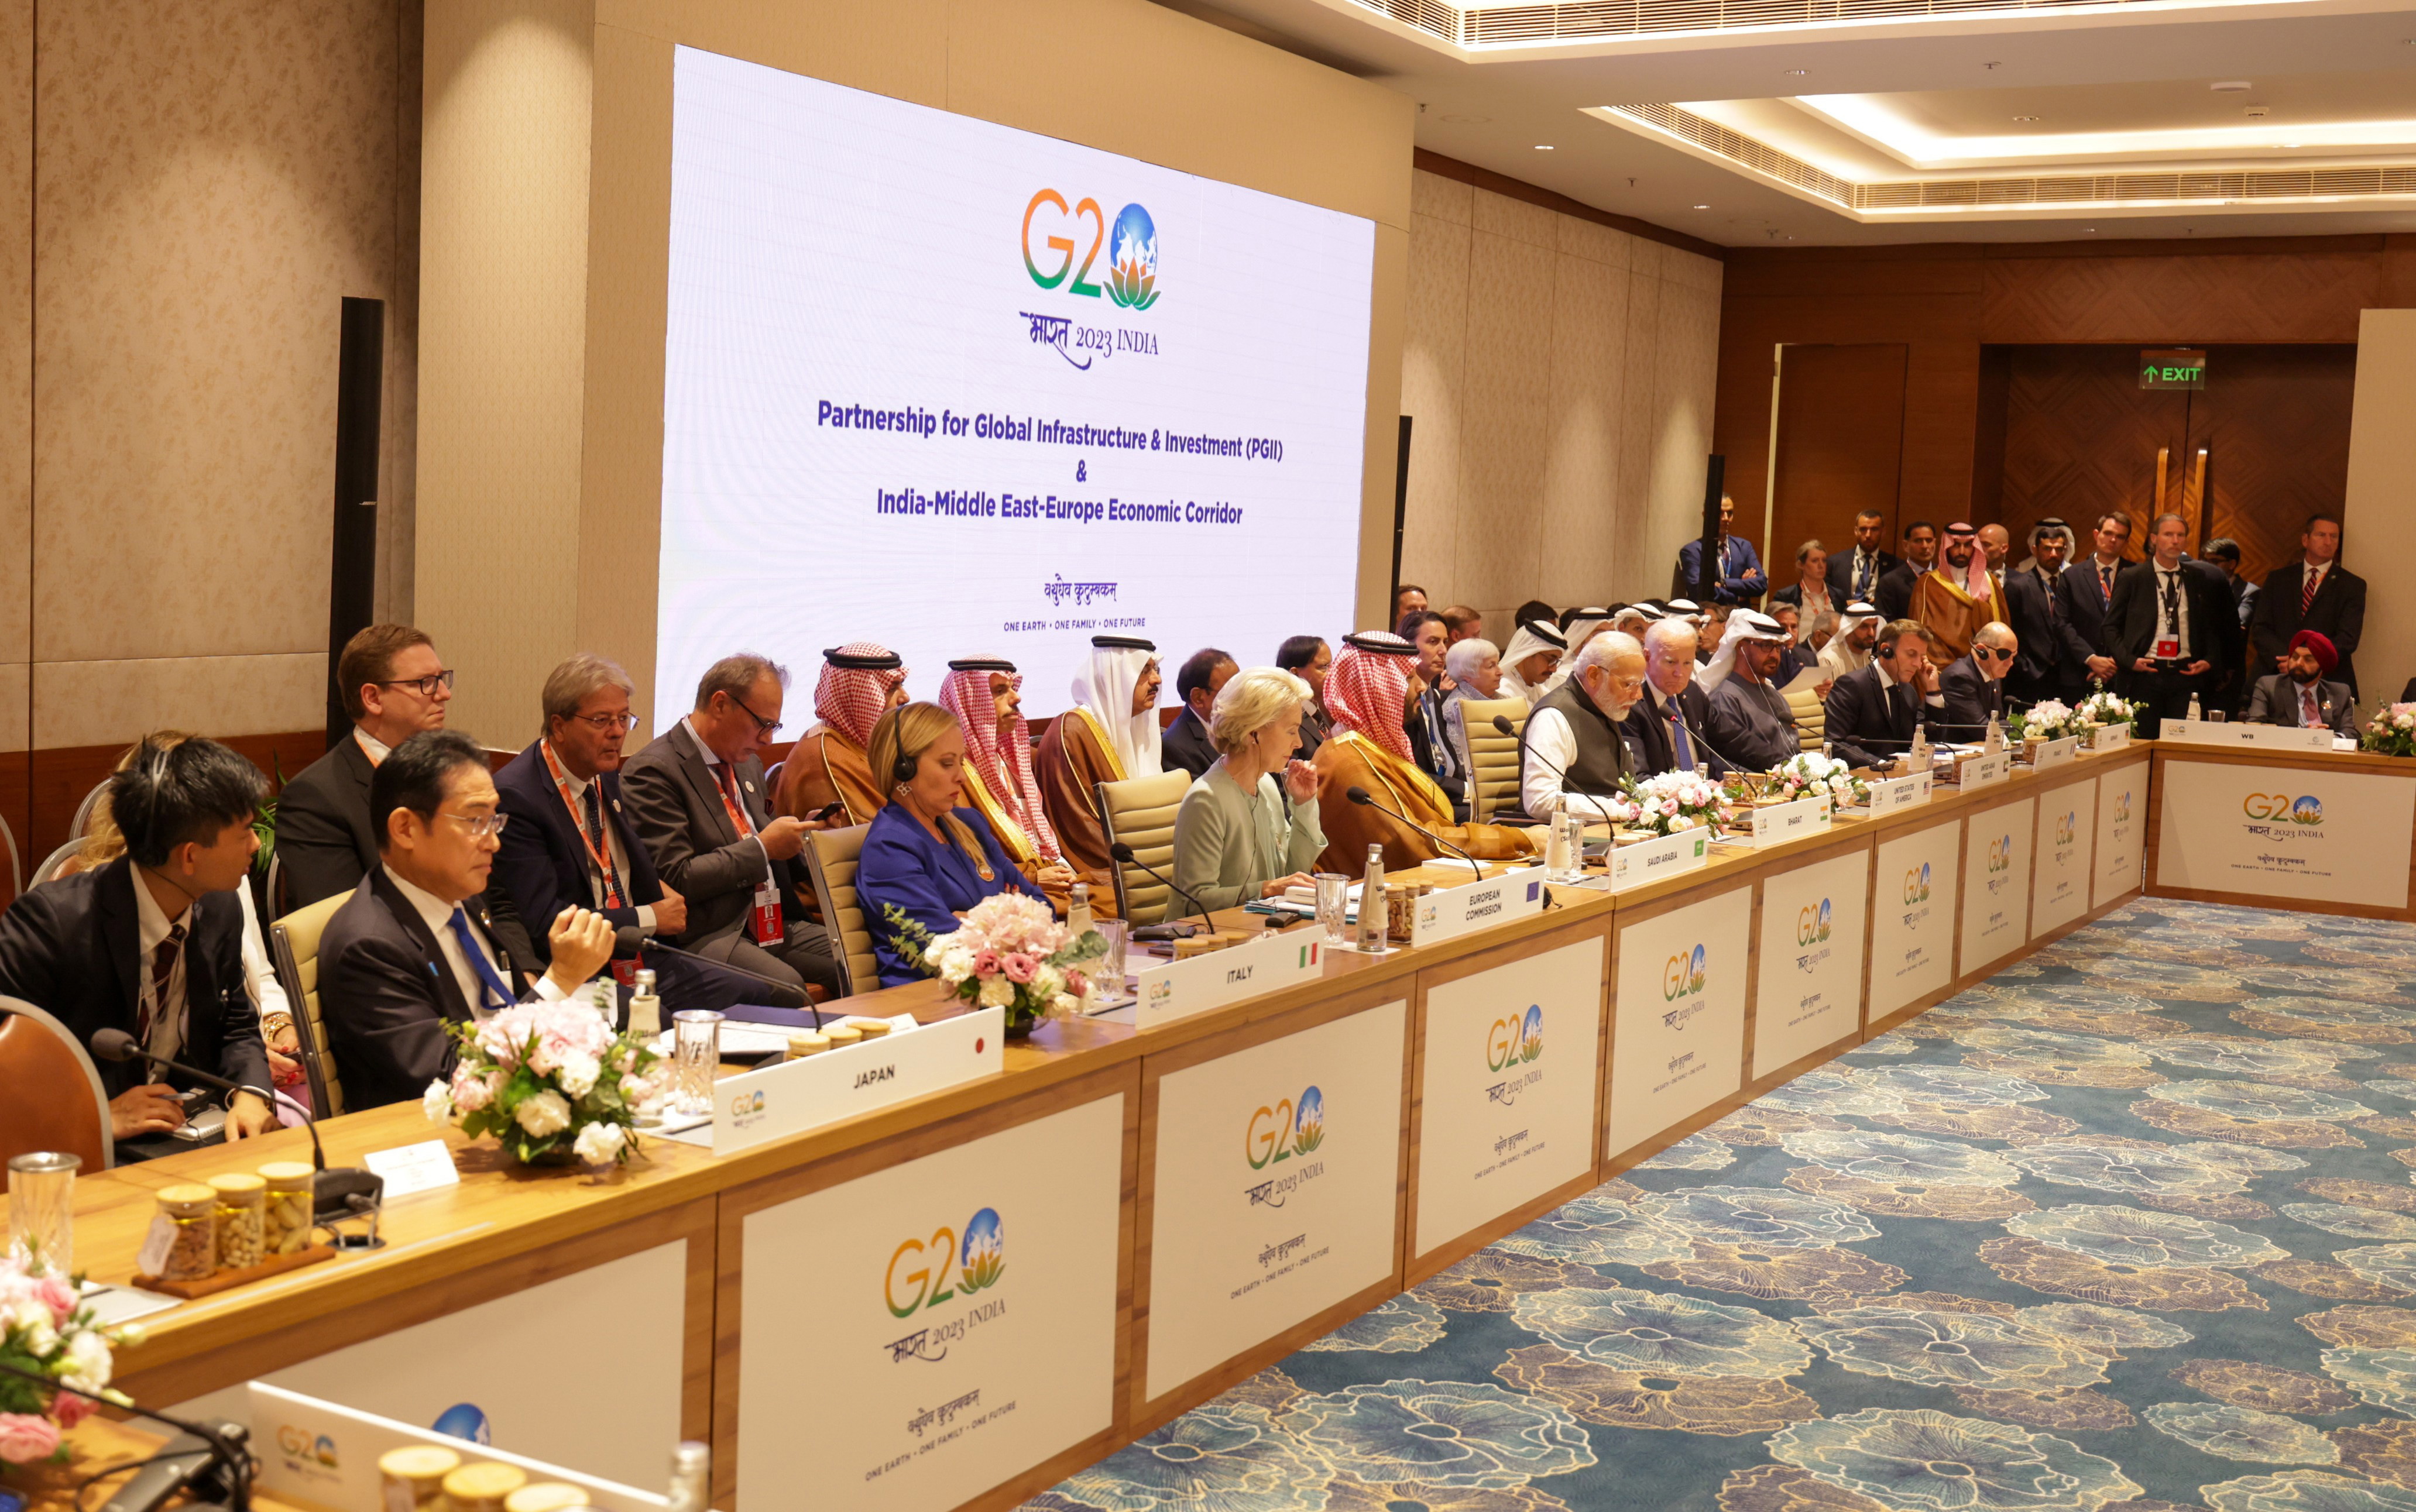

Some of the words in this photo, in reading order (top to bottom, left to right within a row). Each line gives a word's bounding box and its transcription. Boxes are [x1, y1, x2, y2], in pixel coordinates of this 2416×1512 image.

[1021, 188, 1161, 311] G20
[1019, 311, 1092, 370] भारत
[1076, 327, 1112, 358] 2023
[1117, 329, 1159, 355] INDIA
[2162, 367, 2201, 381] EXIT
[818, 400, 936, 438] Partnership
[942, 410, 969, 437] for
[974, 413, 1032, 441] Global
[1037, 419, 1147, 450] Infrastructure
[1151, 428, 1161, 451] &
[1165, 430, 1243, 457] Investment
[1245, 438, 1283, 463] (PGII)
[1076, 459, 1087, 482] &
[877, 487, 996, 517] India-Middle
[1001, 494, 1104, 524] East-Europe
[1109, 498, 1181, 523] Economic
[1185, 500, 1243, 524] Corridor
[1004, 622, 1020, 631] ONE
[1022, 621, 1046, 631] EARTH
[1055, 620, 1069, 630] ONE
[1072, 619, 1096, 629] FAMILY
[1104, 618, 1118, 628] ONE
[1120, 618, 1145, 627] FUTURE
[1788, 816, 1802, 826] BHARAT
[2243, 792, 2324, 826] G20
[2274, 829, 2295, 838] 2023
[2298, 830, 2324, 839] INDIA
[1648, 857, 1661, 867] SAUDI
[1662, 851, 1677, 863] ARABIA
[1470, 889, 1501, 906] EUROPEAN
[1904, 862, 1930, 906] G20
[1466, 902, 1502, 920] COMMISSION
[1797, 898, 1831, 947] G20
[1227, 965, 1253, 984] ITALY
[1664, 943, 1706, 1002] G20
[1679, 1008, 1690, 1020] 2023
[1691, 1000, 1705, 1014] INDIA
[1487, 1004, 1543, 1073] G20
[853, 1063, 895, 1089] JAPAN
[1507, 1078, 1523, 1094] 2023
[1524, 1069, 1542, 1086] INDIA
[1246, 1085, 1325, 1170] G20
[1276, 1174, 1297, 1194] 2023
[1299, 1161, 1324, 1183] INDIA
[1474, 1171, 1482, 1180] ONE
[1483, 1165, 1495, 1176] EARTH
[1508, 1153, 1520, 1163] FAMILY
[1532, 1142, 1545, 1152] FUTURE
[884, 1207, 1006, 1319] G20
[1231, 1288, 1241, 1299] ONE
[1243, 1279, 1260, 1294] EARTH
[1265, 1272, 1276, 1283] ONE
[1278, 1263, 1295, 1277] FAMILY
[1299, 1255, 1310, 1266] ONE
[1311, 1246, 1329, 1260] FUTURE
[932, 1318, 965, 1346] 2023
[969, 1298, 1005, 1328] INDIA
[865, 1466, 882, 1481] ONE
[885, 1452, 911, 1473] EARTH
[919, 1439, 935, 1455] ONE
[938, 1427, 964, 1446] FAMILY
[972, 1414, 987, 1429] ONE
[989, 1400, 1016, 1421] FUTURE
